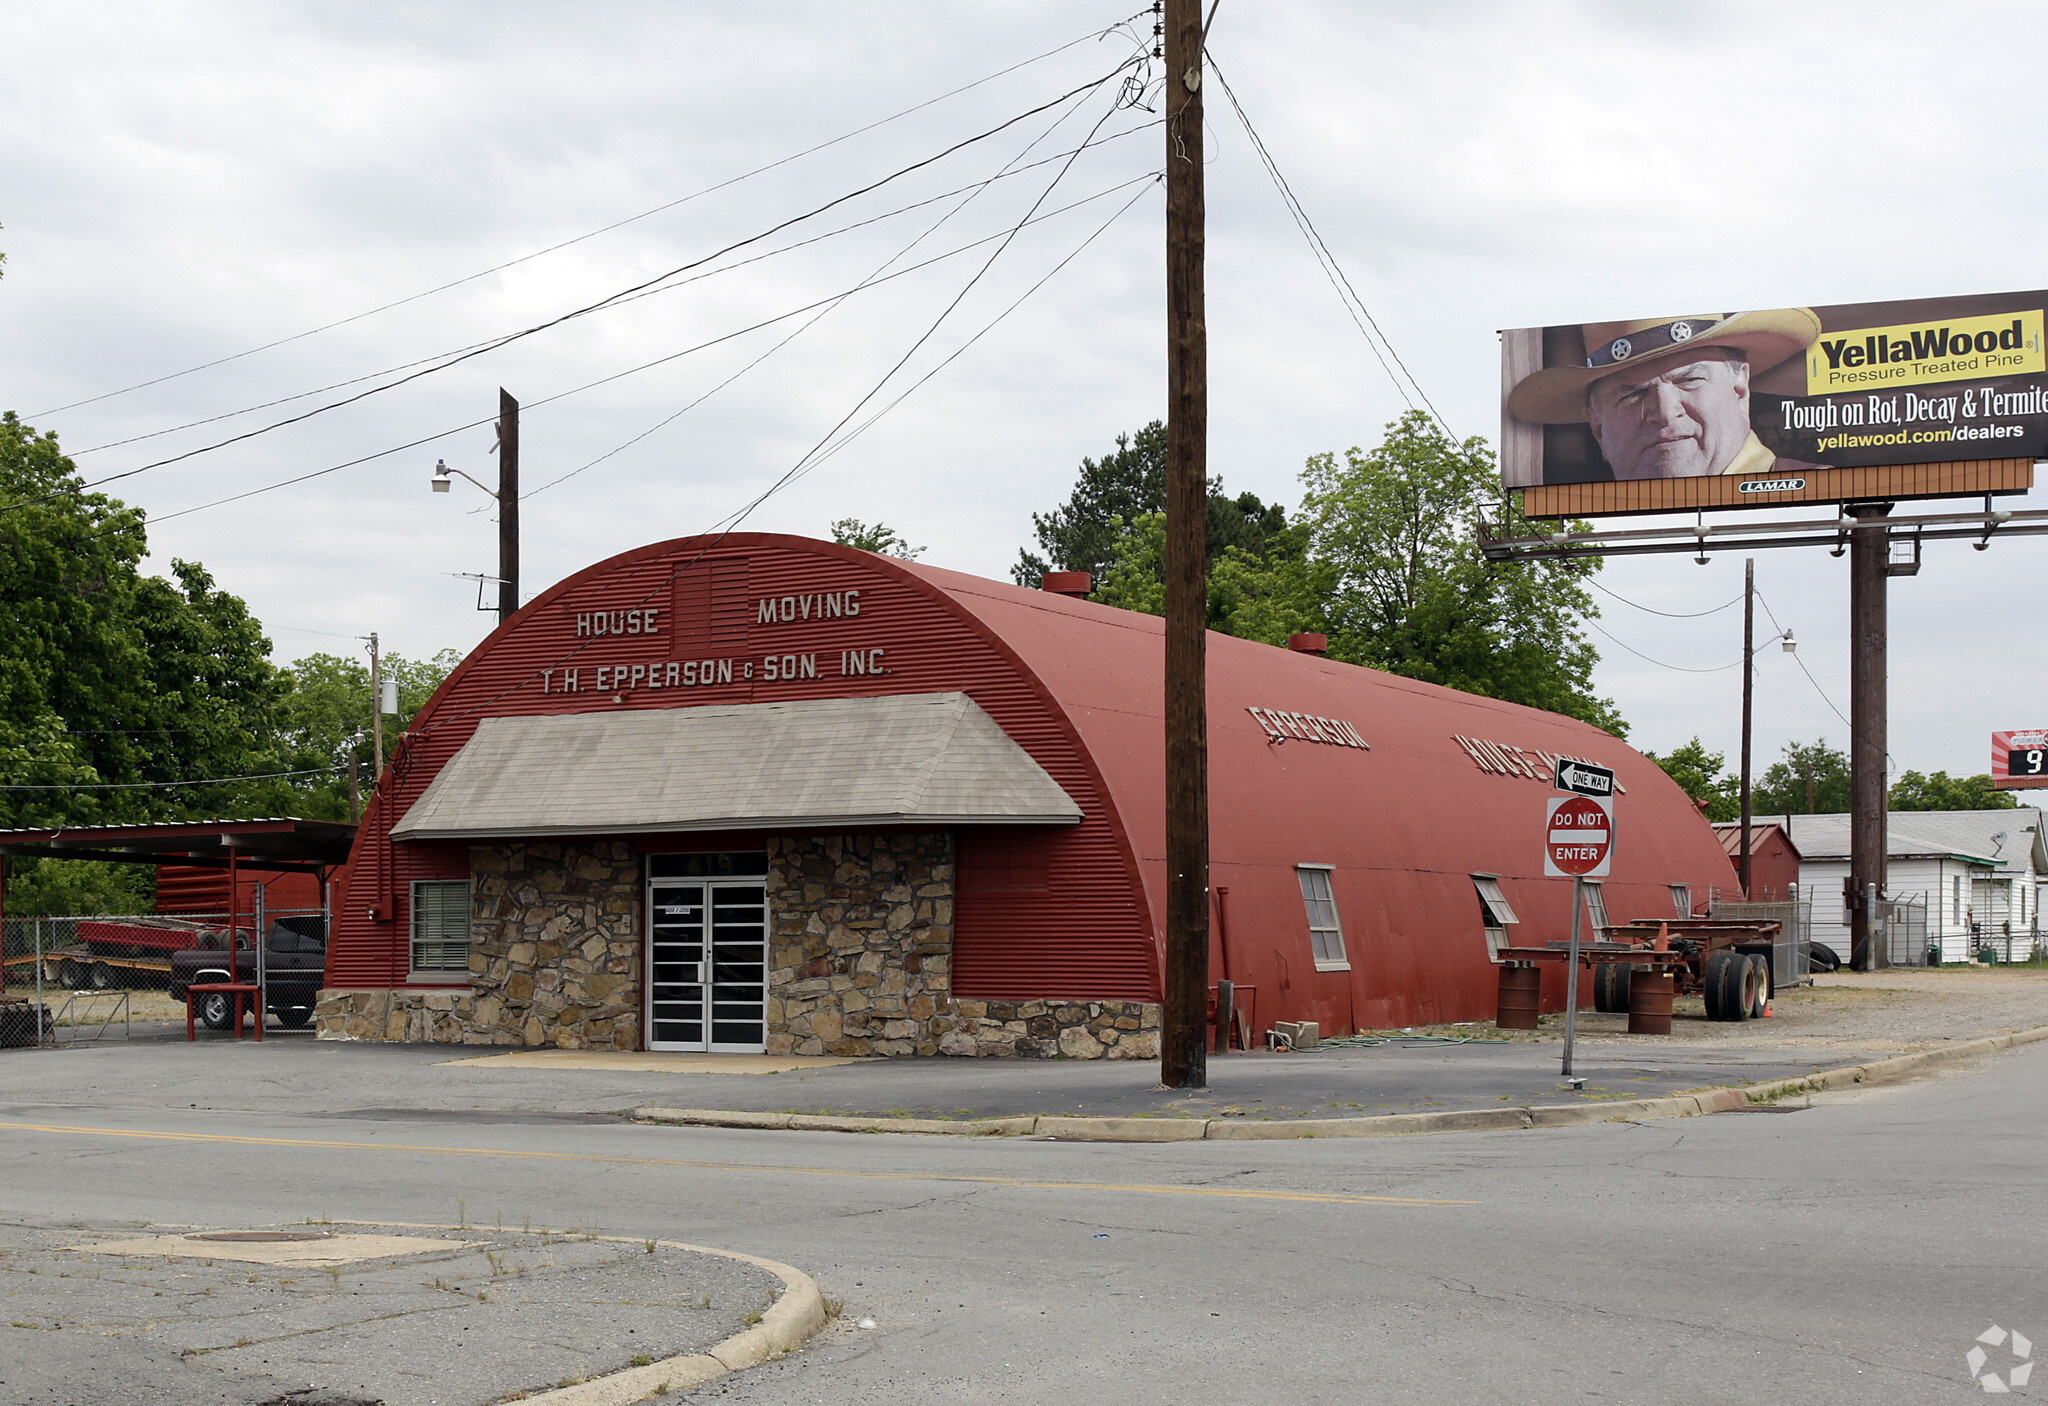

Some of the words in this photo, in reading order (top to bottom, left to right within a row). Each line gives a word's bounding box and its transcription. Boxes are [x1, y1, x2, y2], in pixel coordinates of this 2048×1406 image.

[1829, 366, 1906, 384] Pressure
[1911, 356, 1978, 376] Treated
[1986, 353, 2024, 368] Pine
[1781, 398, 1838, 432] Tough
[1842, 404, 1864, 427] on
[1868, 395, 1902, 427] Rot,
[1905, 392, 1958, 430] Decay
[1961, 388, 1977, 418] &
[1980, 384, 2048, 417] Termite
[1817, 423, 2024, 452] yellawood.com/dealers
[1746, 480, 1798, 491] LAMAR
[577, 609, 659, 637] HOUSE
[757, 590, 860, 624] MOVING
[541, 668, 585, 693] T.H.
[596, 659, 732, 691] EPPERSON
[744, 662, 753, 679] &
[841, 649, 893, 675] INC.
[1247, 706, 1371, 750] EPPERSON
[1453, 734, 1549, 782] HOUSE
[1572, 771, 1589, 786] ONE
[1591, 775, 1608, 789] WAY
[1555, 813, 1573, 826] DO
[1577, 813, 1604, 826] NOT
[1556, 847, 1598, 860] ENTER
